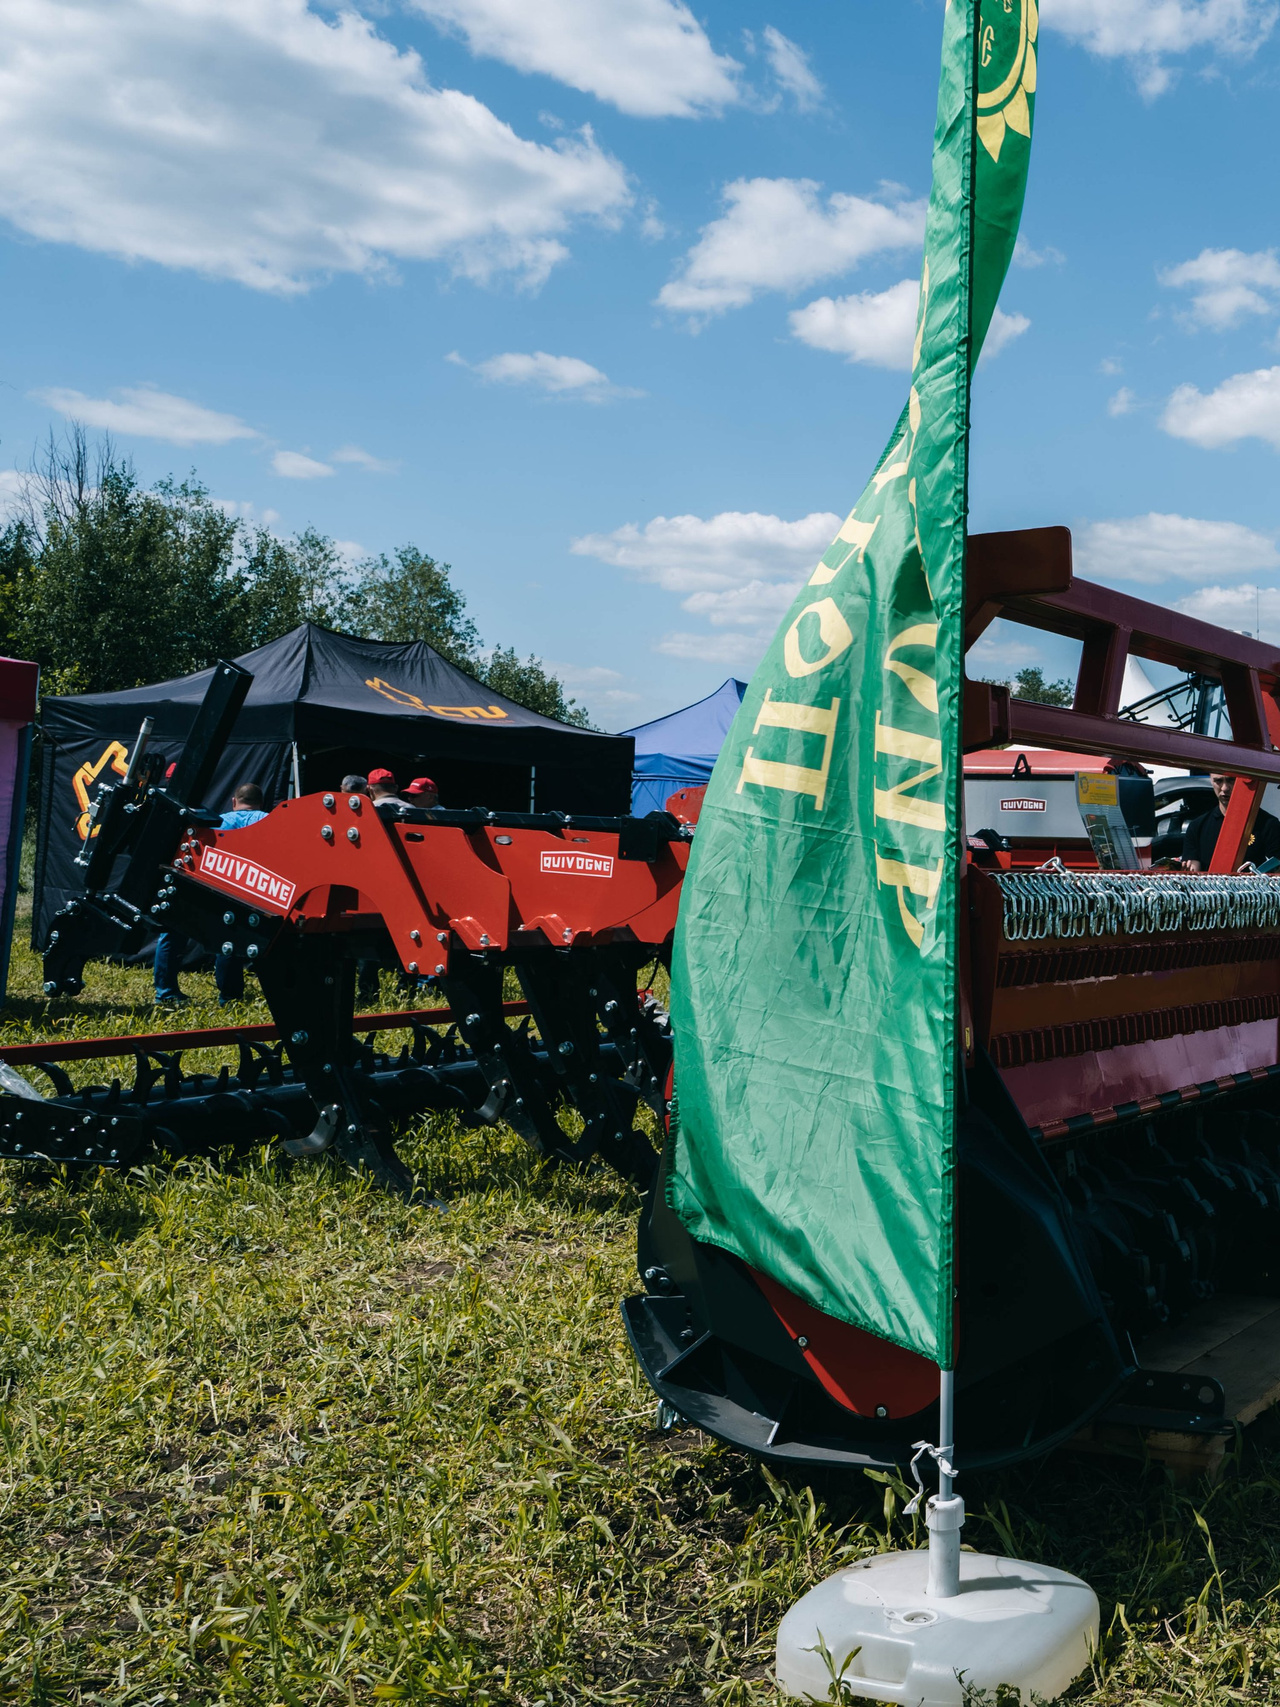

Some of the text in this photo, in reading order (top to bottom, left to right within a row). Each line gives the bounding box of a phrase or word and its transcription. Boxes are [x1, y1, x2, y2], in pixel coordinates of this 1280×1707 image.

[1001, 800, 1046, 812] QUIVOGNE
[542, 856, 612, 875] QUIVOGNE
[204, 852, 292, 904] QUIVOGNE
